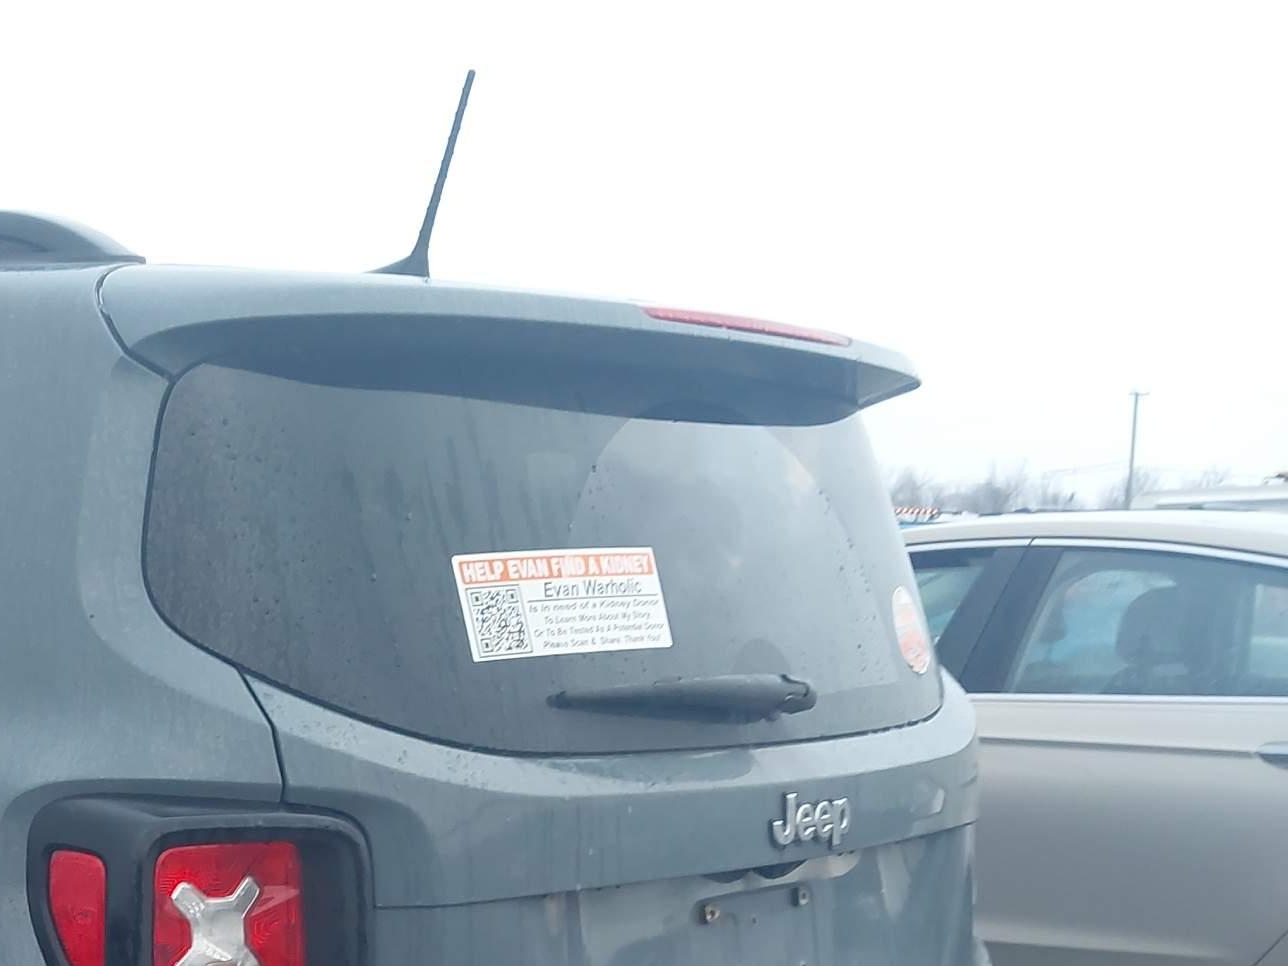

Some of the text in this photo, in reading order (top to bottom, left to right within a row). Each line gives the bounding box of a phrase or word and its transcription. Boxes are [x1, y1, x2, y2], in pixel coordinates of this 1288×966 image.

[463, 554, 649, 583] HELP EVAN FIND A KIDNEY
[544, 579, 642, 598] Evan Warholic
[771, 791, 850, 847] Jeep
